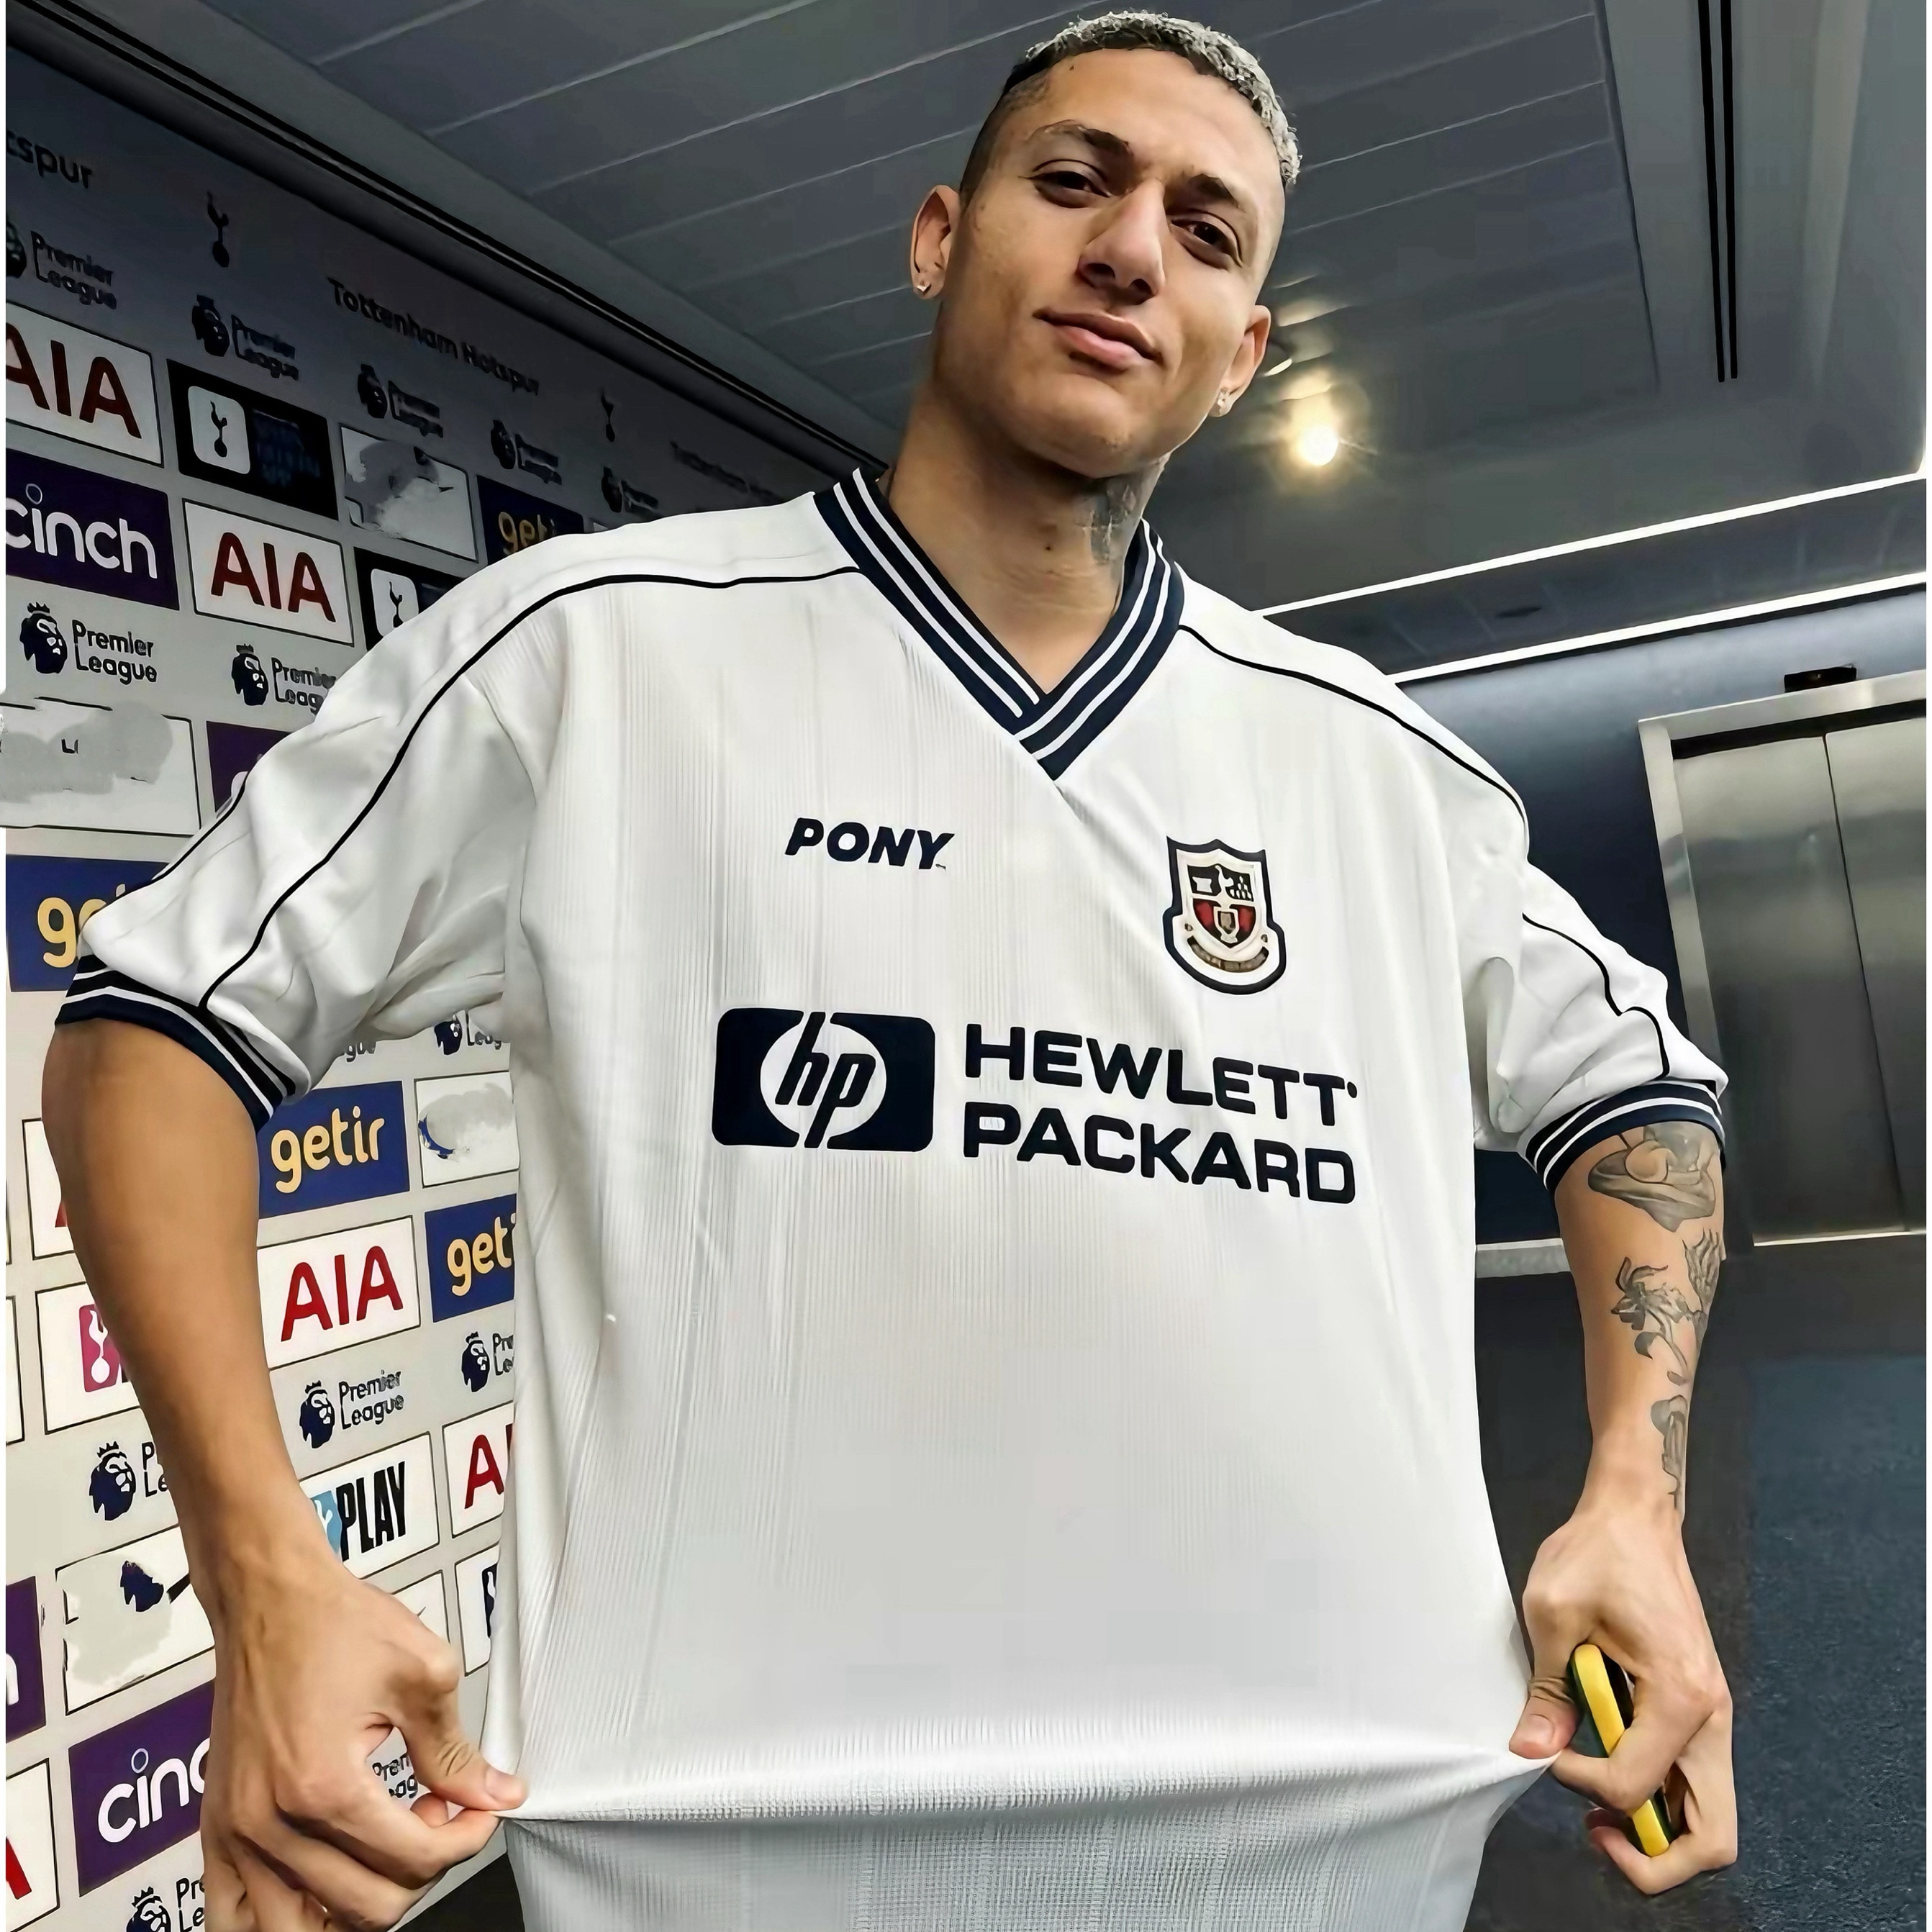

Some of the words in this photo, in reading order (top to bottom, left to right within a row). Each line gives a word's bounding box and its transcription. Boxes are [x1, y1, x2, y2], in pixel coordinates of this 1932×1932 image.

[6, 322, 142, 440] AIA
[6, 483, 158, 579] cinch
[499, 511, 555, 555] get
[211, 532, 336, 623] AIA
[72, 620, 154, 658] Premier
[75, 644, 158, 685] League
[273, 671, 324, 715] Leag
[784, 817, 955, 869] PONY
[775, 1011, 876, 1149] hp
[964, 1023, 1353, 1127] HEWLETT
[271, 1105, 385, 1194] getir
[963, 1102, 1356, 1205] PACKARD
[281, 1246, 404, 1342] AIA
[447, 1212, 516, 1297] get
[338, 1369, 402, 1402] Premier
[341, 1394, 404, 1430] League
[336, 1461, 406, 1561] PLAY
[98, 1737, 210, 1843] cinc
